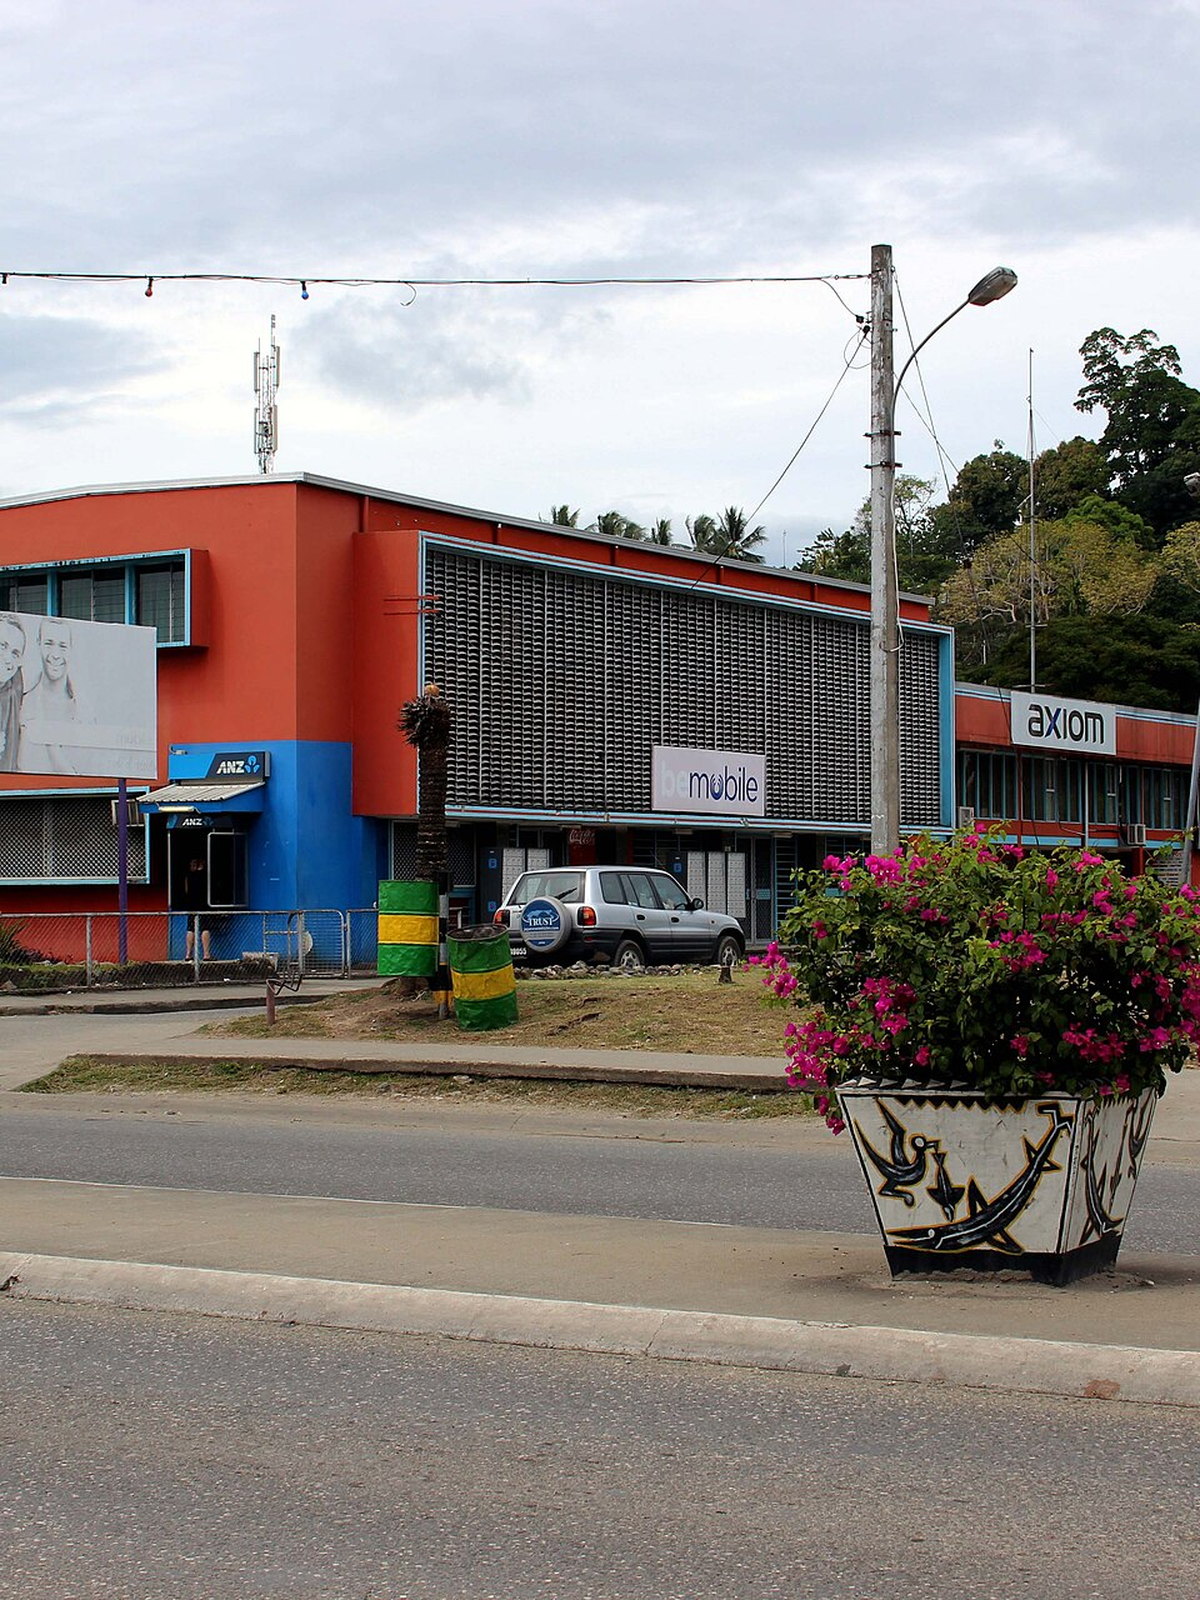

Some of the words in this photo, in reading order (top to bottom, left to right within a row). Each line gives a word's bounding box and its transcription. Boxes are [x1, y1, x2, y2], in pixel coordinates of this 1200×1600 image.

[1028, 704, 1105, 744] axiom
[216, 760, 245, 774] ANZ
[182, 818, 203, 826] ANZ
[528, 917, 554, 927] TRUST
